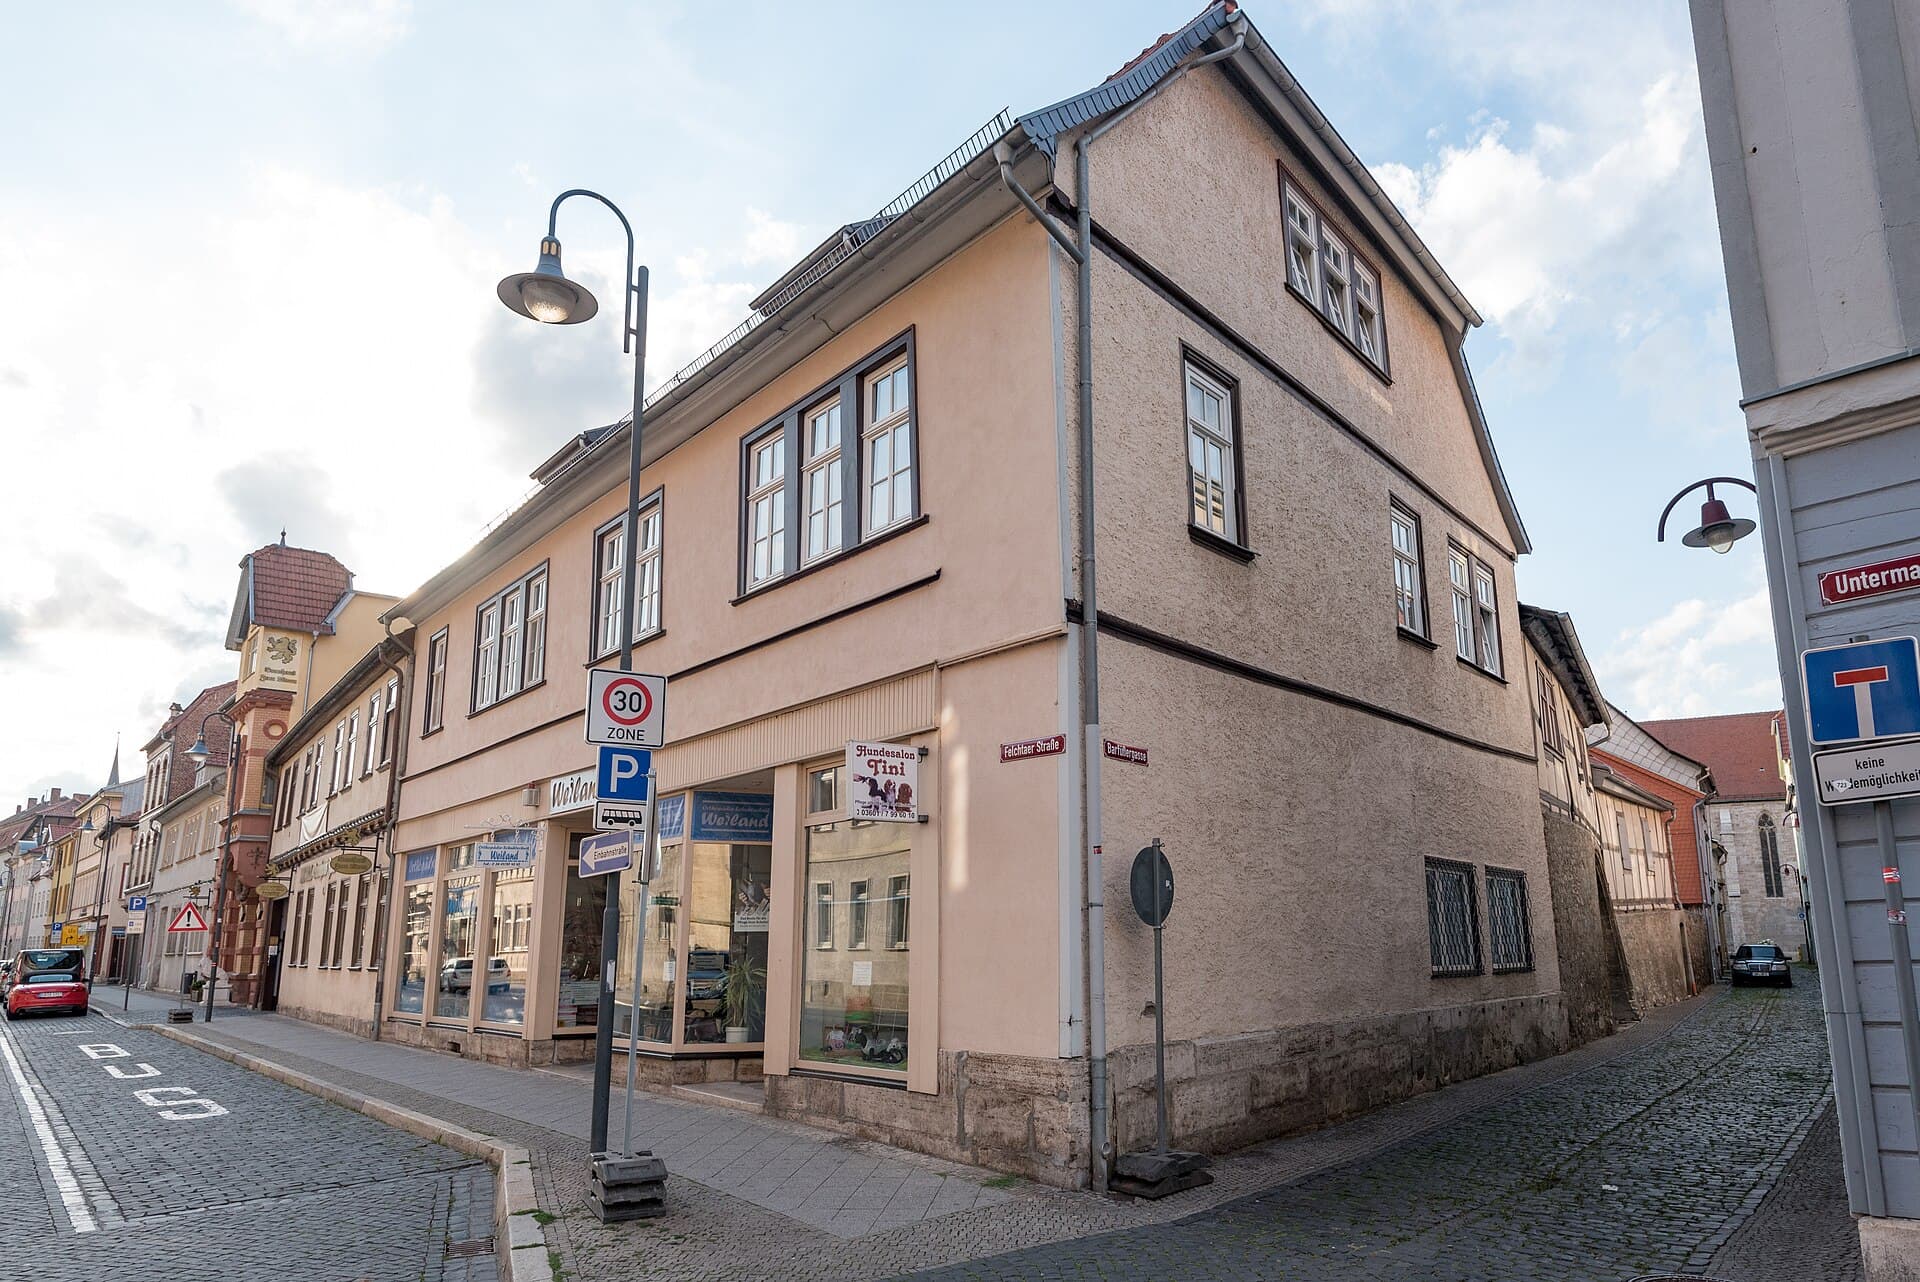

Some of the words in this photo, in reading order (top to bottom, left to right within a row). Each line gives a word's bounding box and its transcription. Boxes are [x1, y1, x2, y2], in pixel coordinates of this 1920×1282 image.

[1835, 564, 1920, 595] Unterma
[613, 690, 642, 713] 30
[607, 727, 645, 741] ZONE
[856, 745, 915, 760] Hundesalon
[1004, 742, 1034, 758] Felchtaer
[1036, 738, 1059, 753] Straße
[867, 759, 905, 776] Tini
[1855, 757, 1885, 770] keine
[610, 753, 639, 793] P
[1825, 769, 1920, 793] Wdemöglichkei
[701, 811, 769, 828] Weiland
[490, 850, 519, 860] Weiland
[593, 845, 627, 860] Einbahnstraße
[133, 899, 142, 909] P
[77, 1043, 230, 1121] BUS
